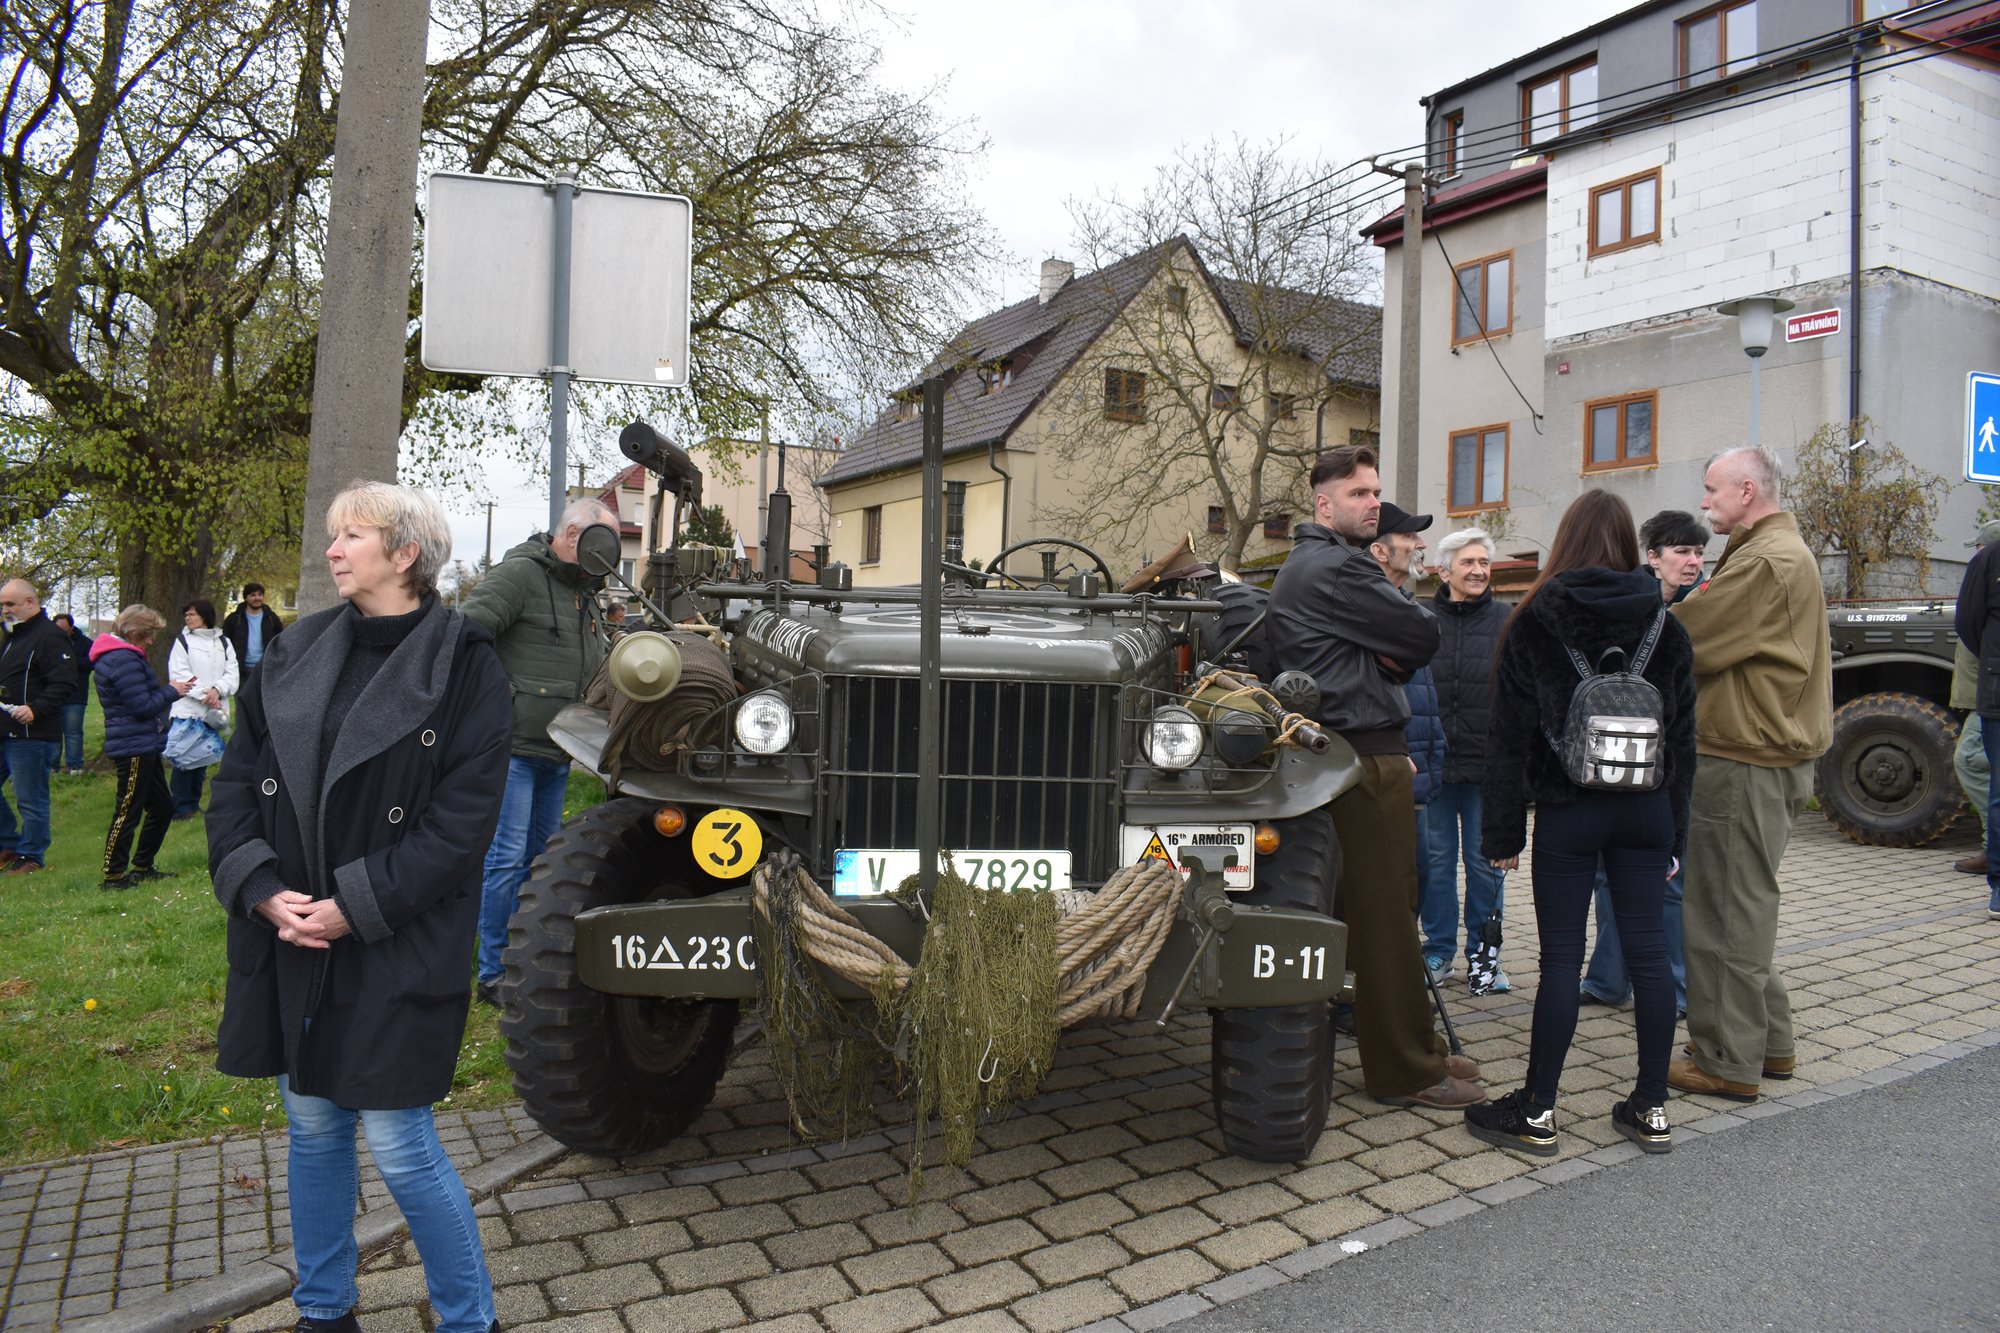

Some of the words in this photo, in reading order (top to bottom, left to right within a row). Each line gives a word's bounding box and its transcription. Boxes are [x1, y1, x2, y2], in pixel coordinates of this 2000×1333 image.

[1789, 323, 1800, 335] NA
[1801, 315, 1837, 332] TRÁVNÍKU
[1847, 614, 1863, 622] U.S.
[1601, 723, 1648, 785] 81
[709, 822, 743, 867] 3
[1150, 844, 1163, 854] 16
[1191, 833, 1246, 846] ARMORED
[868, 857, 887, 892] V
[964, 858, 1053, 893] 7829
